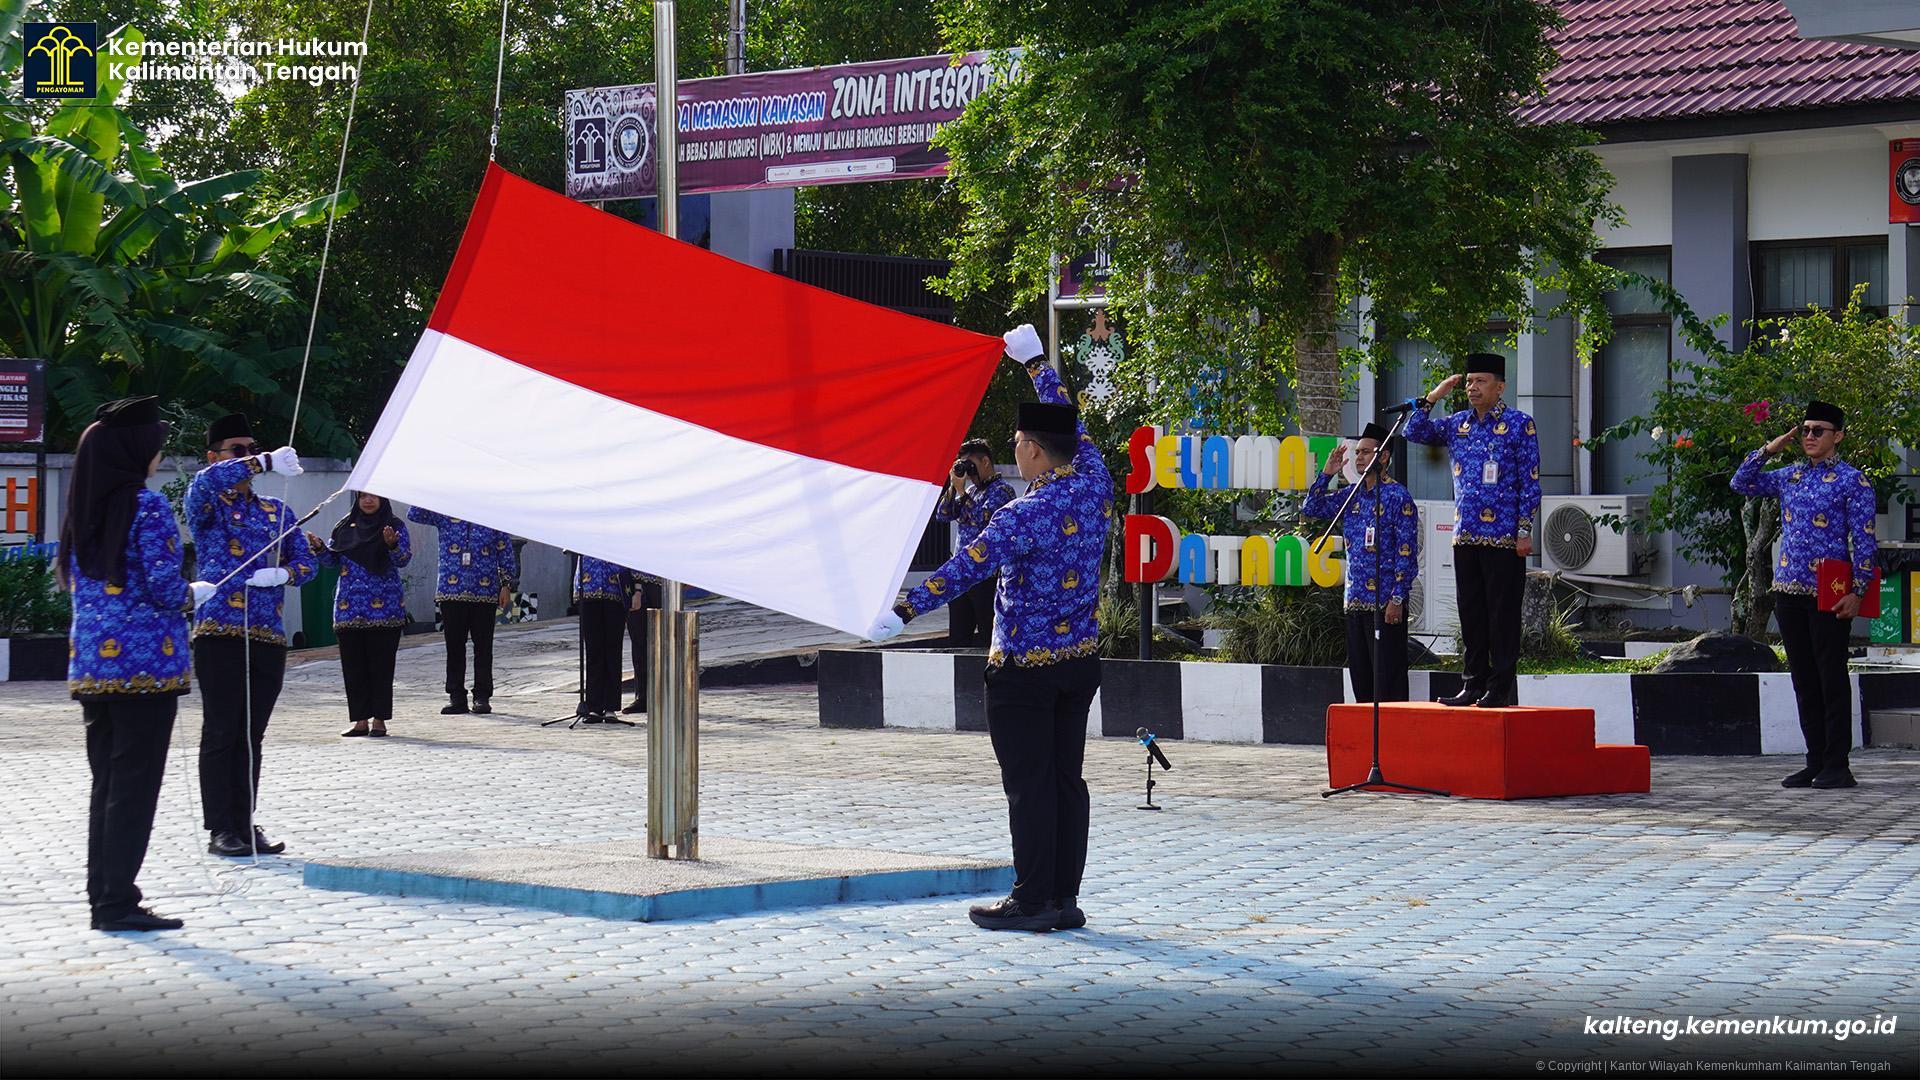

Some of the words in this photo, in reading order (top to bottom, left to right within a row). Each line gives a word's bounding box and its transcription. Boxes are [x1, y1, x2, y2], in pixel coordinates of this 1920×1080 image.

[692, 96, 760, 132] MEMASUKI
[760, 91, 826, 126] KAWASAN
[830, 73, 887, 119] ZONA
[686, 140, 708, 161] BEBAS
[709, 139, 726, 160] DARI
[727, 137, 759, 159] KORUPSI
[759, 132, 786, 161] (WBK)
[786, 139, 792, 154] &
[793, 133, 822, 153] MENUJU
[823, 129, 855, 151] WILAYAH
[856, 125, 896, 148] BIROKRASI
[898, 123, 925, 145] BERSIH
[1125, 425, 1343, 494] SELAMAT
[1124, 514, 1346, 588] DATANG
